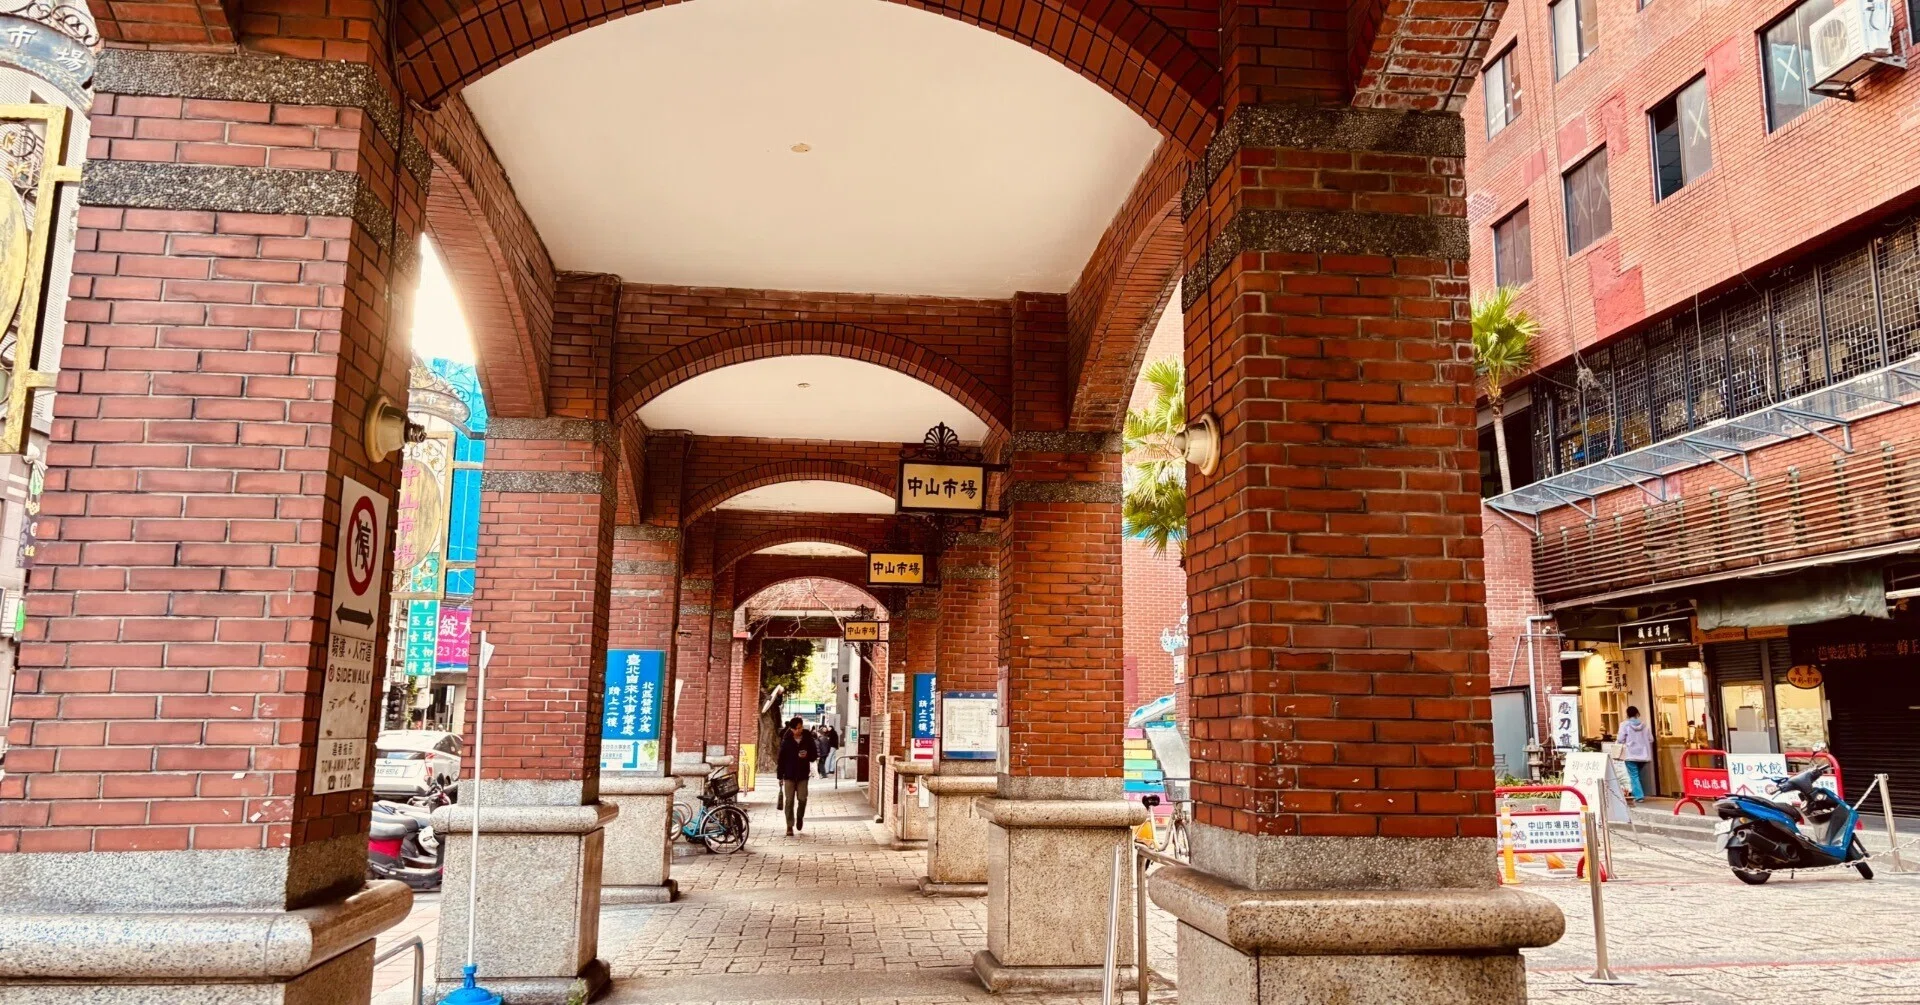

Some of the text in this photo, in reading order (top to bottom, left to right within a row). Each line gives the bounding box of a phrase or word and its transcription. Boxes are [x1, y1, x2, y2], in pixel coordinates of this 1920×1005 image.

[8, 25, 87, 72] 市場
[907, 476, 978, 500] 中山市場
[394, 465, 421, 567] 中山市場
[354, 519, 372, 570] 停
[873, 561, 920, 576] 中山市場
[411, 615, 434, 627] 玉石
[847, 626, 877, 636] 中山市場
[336, 667, 371, 685] SIDEWALK
[605, 686, 621, 728] 請上二樓
[918, 699, 928, 732] 請上二樓
[340, 773, 352, 789] 110
[1693, 779, 1728, 790] 中山市場
[1528, 821, 1579, 829] 中山市場用地
